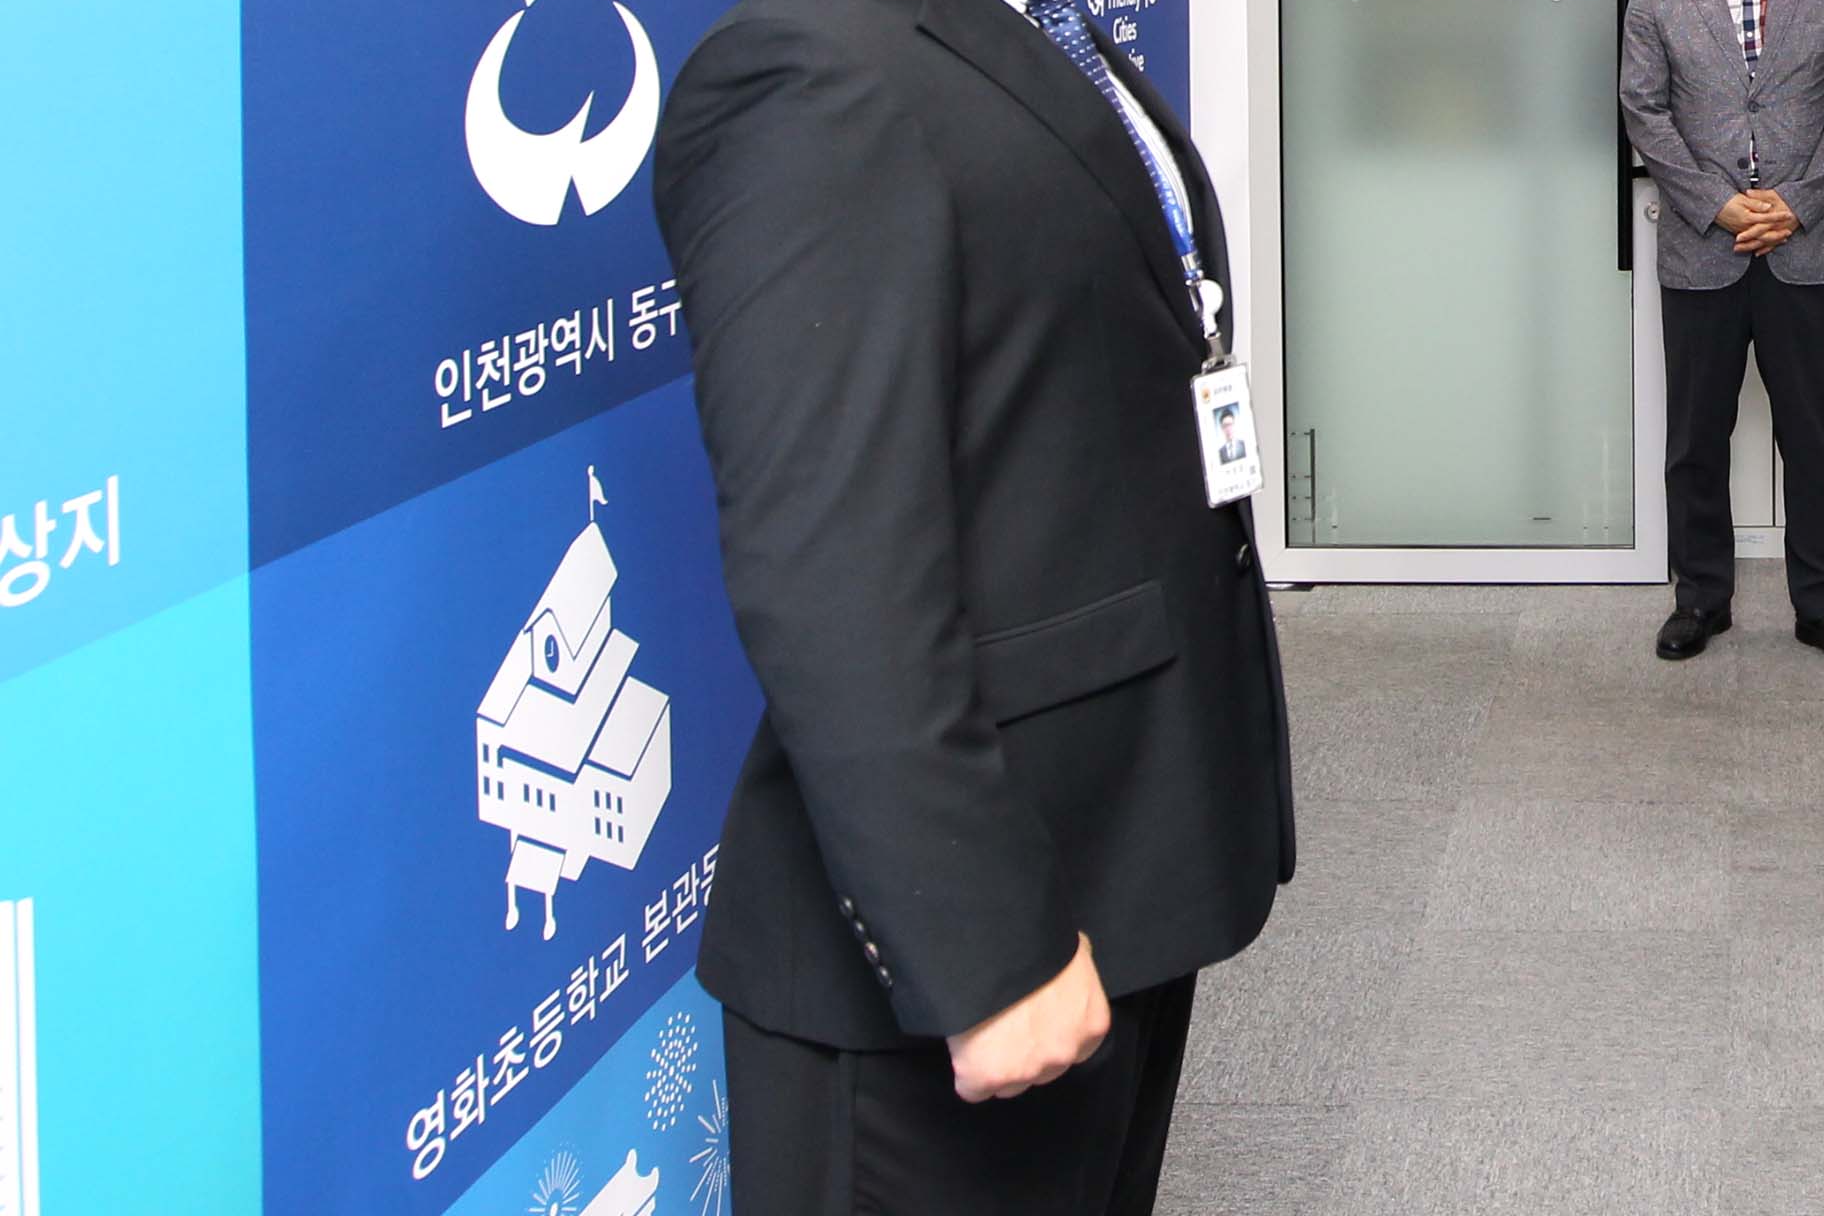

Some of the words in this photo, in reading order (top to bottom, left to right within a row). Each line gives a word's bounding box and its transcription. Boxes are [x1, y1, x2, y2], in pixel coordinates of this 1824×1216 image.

[1112, 15, 1138, 45] Cities
[434, 298, 615, 429] 인천광역시
[628, 278, 683, 351] 동구
[405, 932, 631, 1181] 영화초등학교
